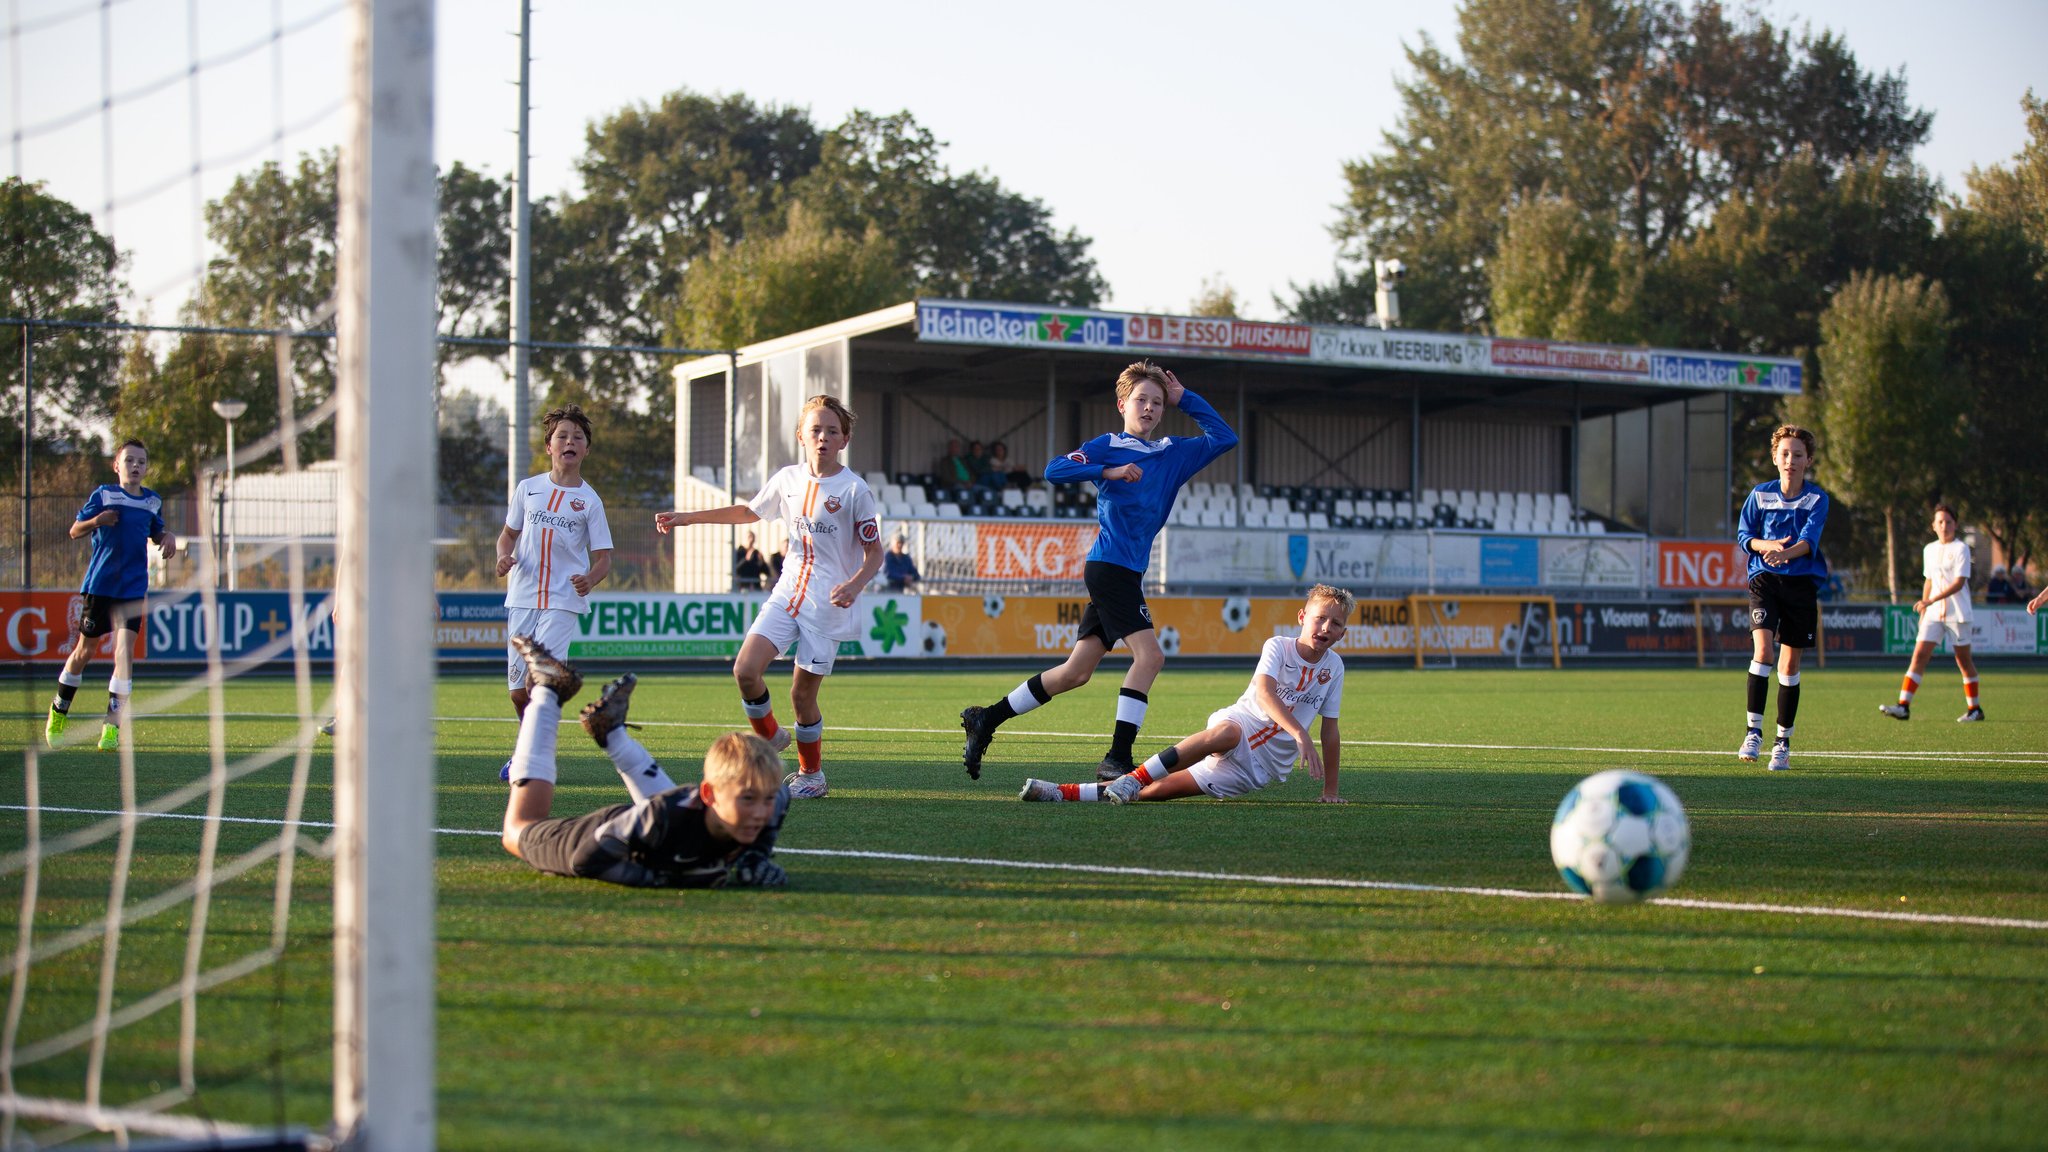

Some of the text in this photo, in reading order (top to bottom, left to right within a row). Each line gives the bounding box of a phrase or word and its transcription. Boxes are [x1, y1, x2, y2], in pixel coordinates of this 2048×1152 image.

[920, 308, 1039, 342] Heineken
[1185, 321, 1309, 350] ESSO HUISMAN
[1383, 340, 1463, 363] MEERBURG
[1652, 357, 1738, 385] Heineken
[985, 536, 1068, 576] ING
[1315, 550, 1374, 578] Meer
[1664, 551, 1725, 586] ING
[152, 602, 254, 652] STOLP
[578, 602, 744, 635] VERHAGEN
[1361, 605, 1408, 625] HALLO
[1527, 603, 1595, 645] Smit
[1601, 607, 1648, 627] Vloeren
[582, 642, 726, 655] SCHOONMAAKMACHINES
